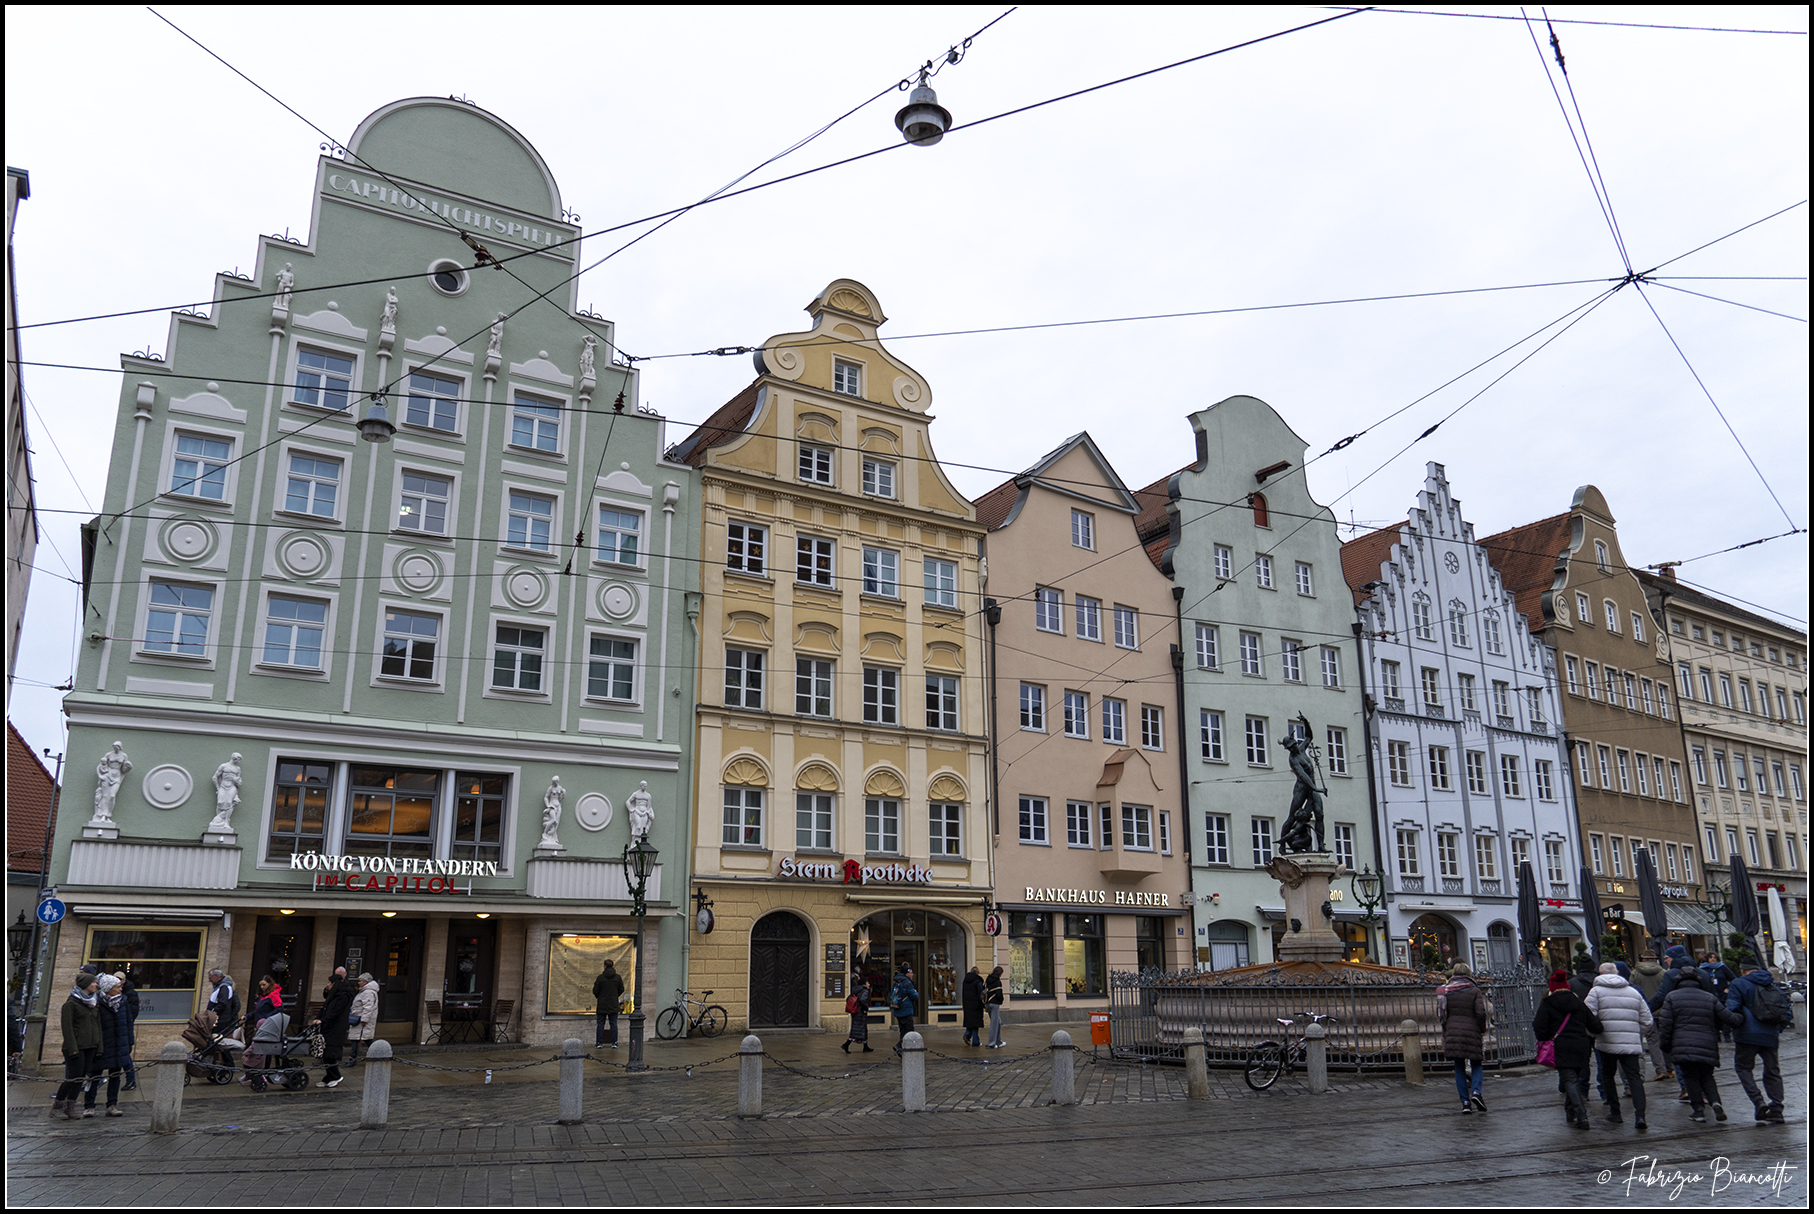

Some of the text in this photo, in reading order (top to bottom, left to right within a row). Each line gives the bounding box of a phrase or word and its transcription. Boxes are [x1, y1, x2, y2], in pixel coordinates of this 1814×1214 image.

[290, 850, 499, 877] KÖNIG VON FLANDERN
[778, 856, 935, 886] Stern Apotheke
[317, 874, 460, 894] IM CAPITOL
[1025, 886, 1106, 904] BANKHAUS
[1115, 890, 1170, 907] HAFNER
[1329, 889, 1344, 902] ano
